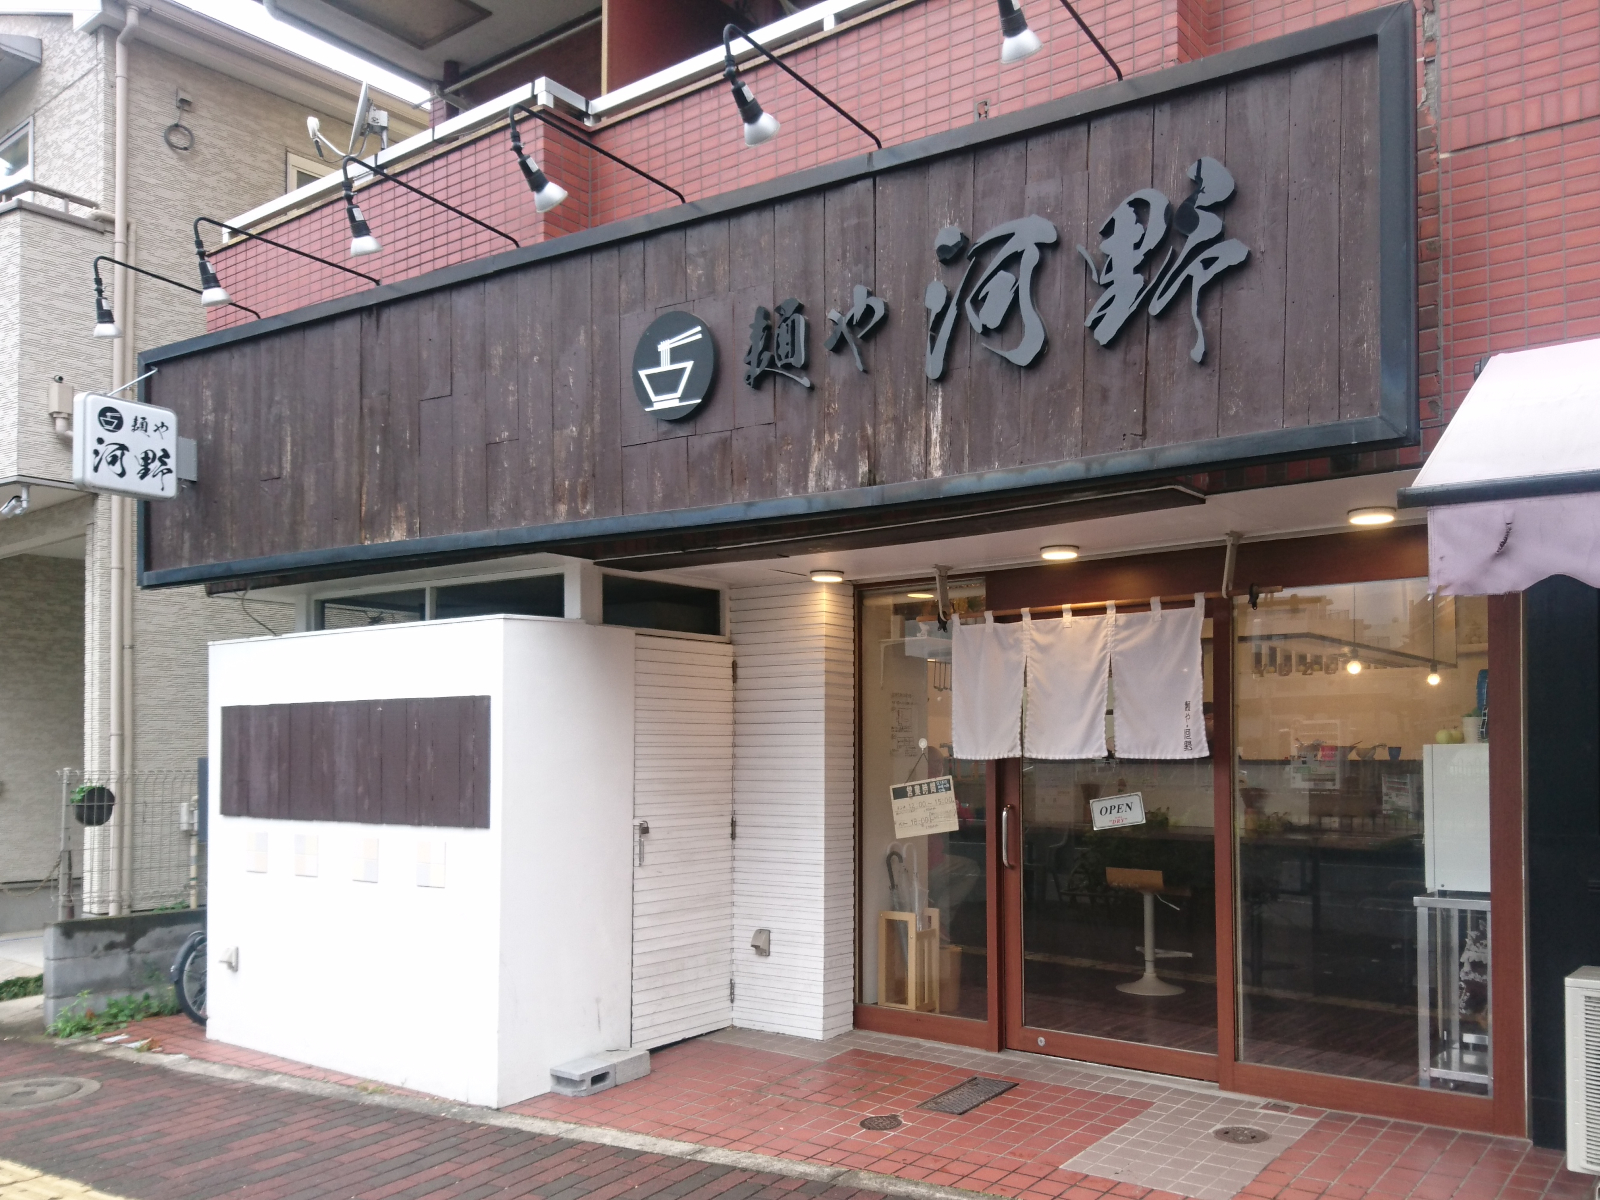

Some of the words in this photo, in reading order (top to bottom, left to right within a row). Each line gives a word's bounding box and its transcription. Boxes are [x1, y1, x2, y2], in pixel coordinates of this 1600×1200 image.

[924, 156, 1252, 381] 河野
[92, 437, 174, 492] 河野
[1099, 801, 1134, 816] OPEN
